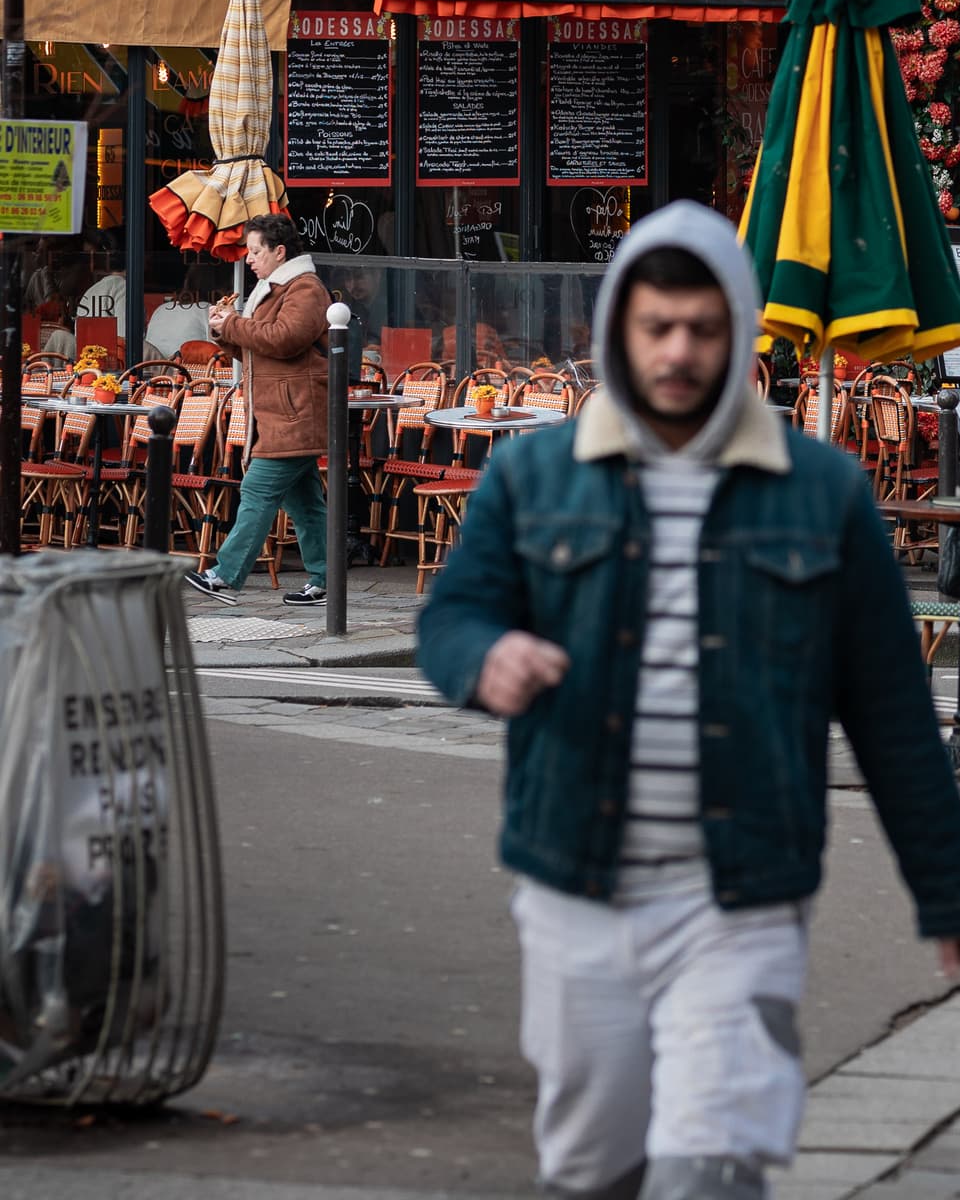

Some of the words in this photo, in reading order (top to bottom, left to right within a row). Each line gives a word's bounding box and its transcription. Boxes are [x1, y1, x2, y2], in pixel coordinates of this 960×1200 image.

[302, 17, 375, 36] ODESSA
[434, 19, 504, 38] ODESSA
[563, 21, 632, 40] ODESSA
[572, 43, 617, 51] VIANDES
[33, 63, 104, 95] RIEN
